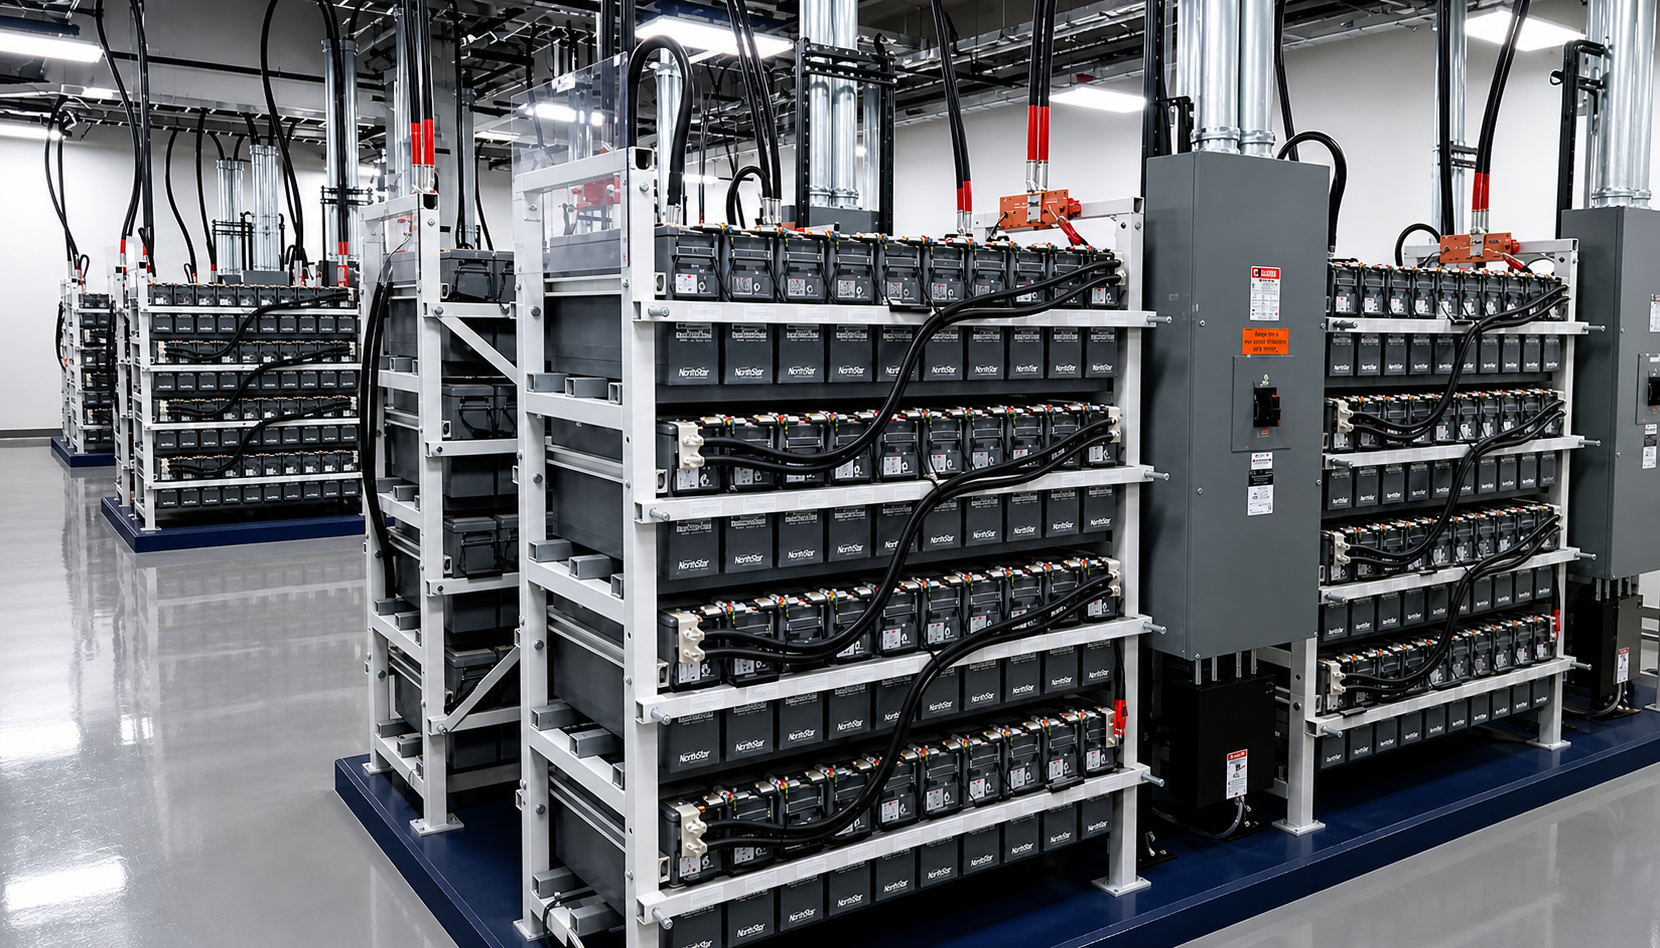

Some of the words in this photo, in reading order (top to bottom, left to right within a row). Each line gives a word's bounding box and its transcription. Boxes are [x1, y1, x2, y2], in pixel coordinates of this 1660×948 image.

[679, 367, 710, 377] NorthStar
[735, 367, 764, 377] NorthStar
[788, 366, 816, 376] NorthStar
[838, 366, 865, 376] NorthStar
[788, 549, 815, 559] NorthStar
[837, 544, 863, 554] NorthStar
[679, 559, 709, 570] NorthStar
[735, 554, 764, 565] NorthStar
[837, 720, 863, 732] NorthStar
[788, 729, 815, 741] NorthStar
[735, 740, 765, 751] NorthStar
[679, 750, 710, 763] NorthStar
[837, 894, 863, 907] NorthStar
[789, 908, 815, 922] NorthStar
[737, 923, 765, 937] NorthStar
